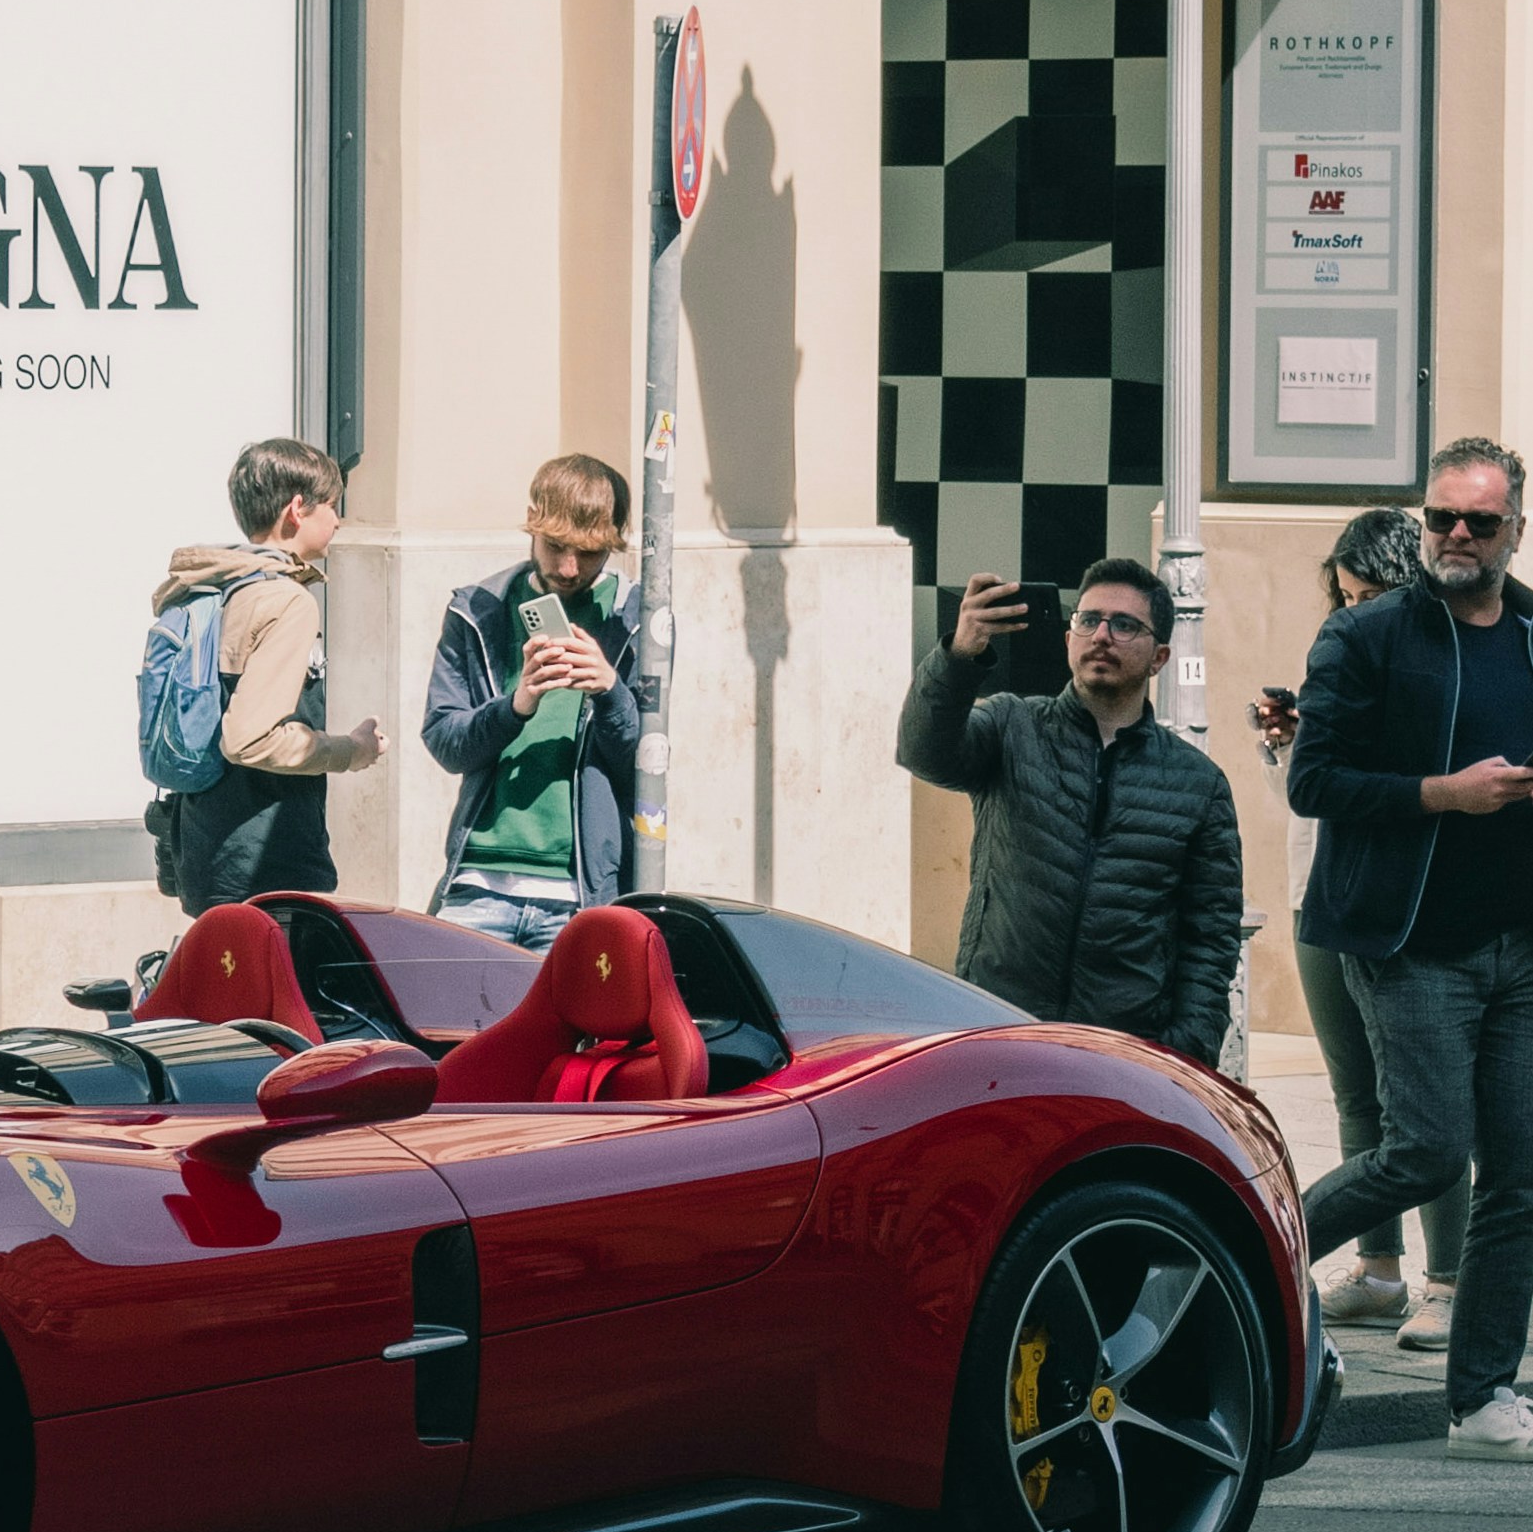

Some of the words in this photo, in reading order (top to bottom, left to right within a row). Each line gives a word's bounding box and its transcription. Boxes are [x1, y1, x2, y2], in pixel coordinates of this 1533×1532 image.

[1269, 35, 1394, 50] ROTHKOPF
[1310, 162, 1363, 178] Pinakos
[1309, 190, 1346, 210] AAF
[1292, 230, 1363, 249] TmaxSoft
[15, 354, 111, 390] SOON
[1282, 371, 1372, 384] INSTINCTIF
[1185, 662, 1202, 680] 14
